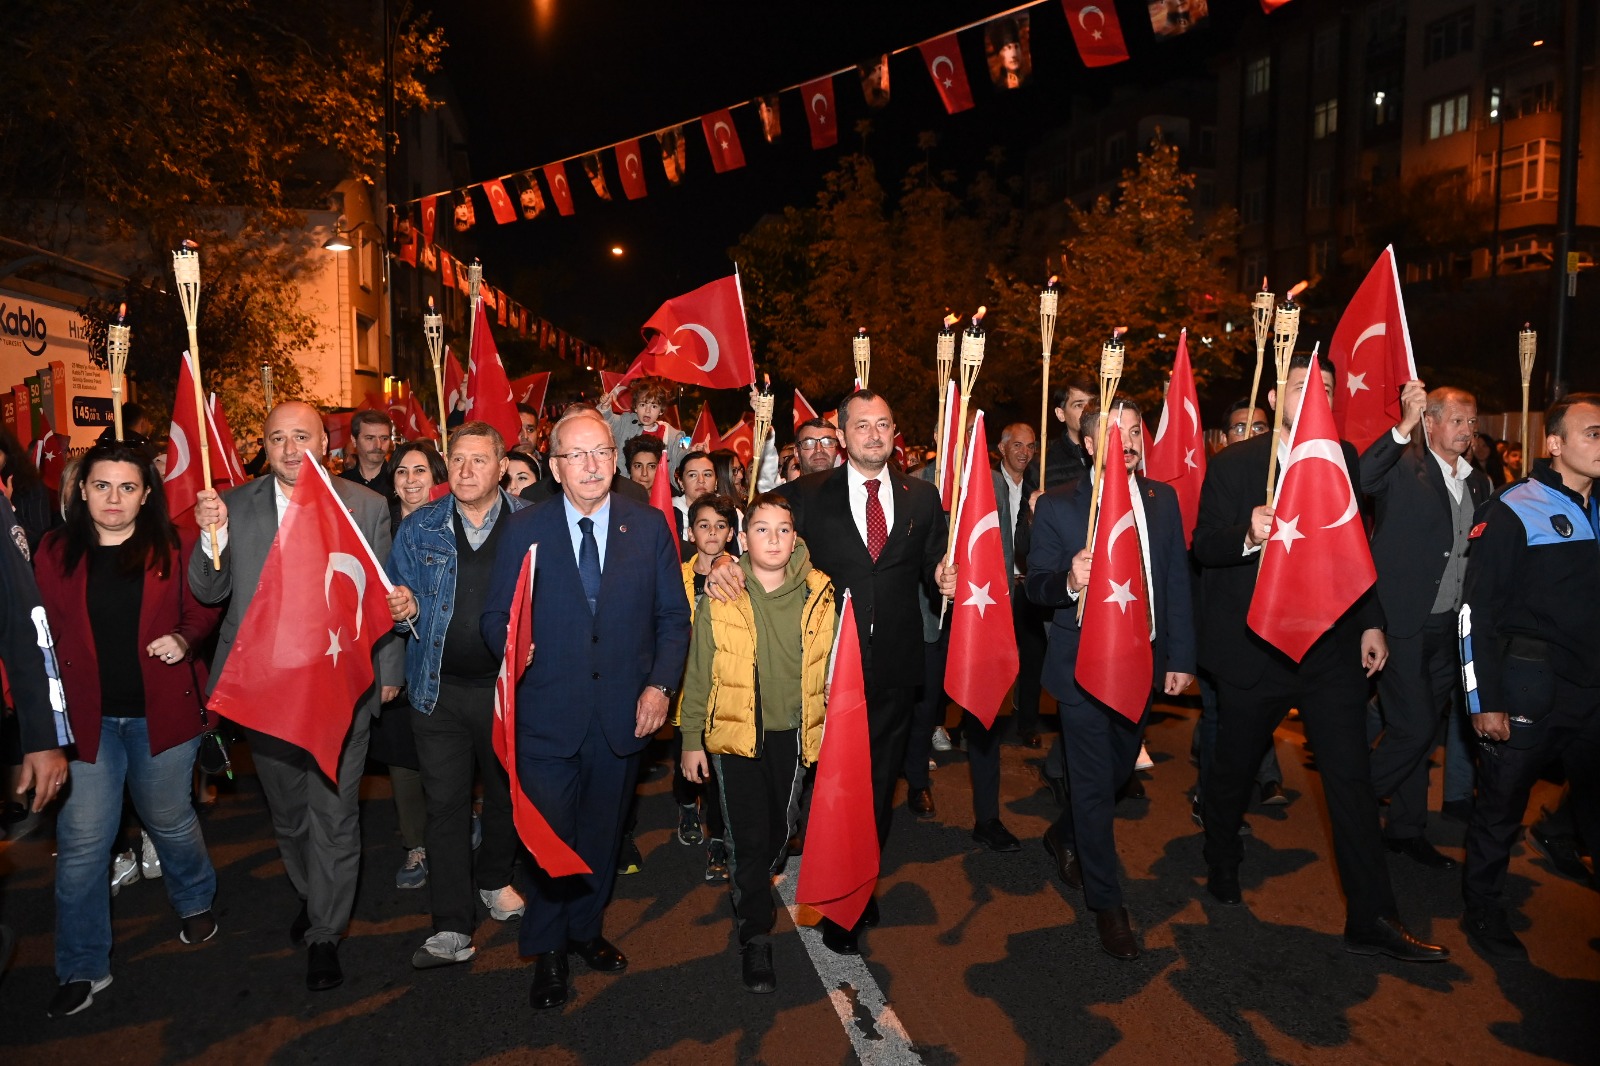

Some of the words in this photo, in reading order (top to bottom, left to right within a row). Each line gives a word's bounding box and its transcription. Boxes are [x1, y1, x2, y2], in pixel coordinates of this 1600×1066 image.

[0, 303, 47, 340] Kablo
[53, 367, 65, 379] 100
[43, 376, 51, 389] 75
[31, 384, 39, 397] 50
[18, 392, 27, 404] 35
[5, 403, 13, 416] 25
